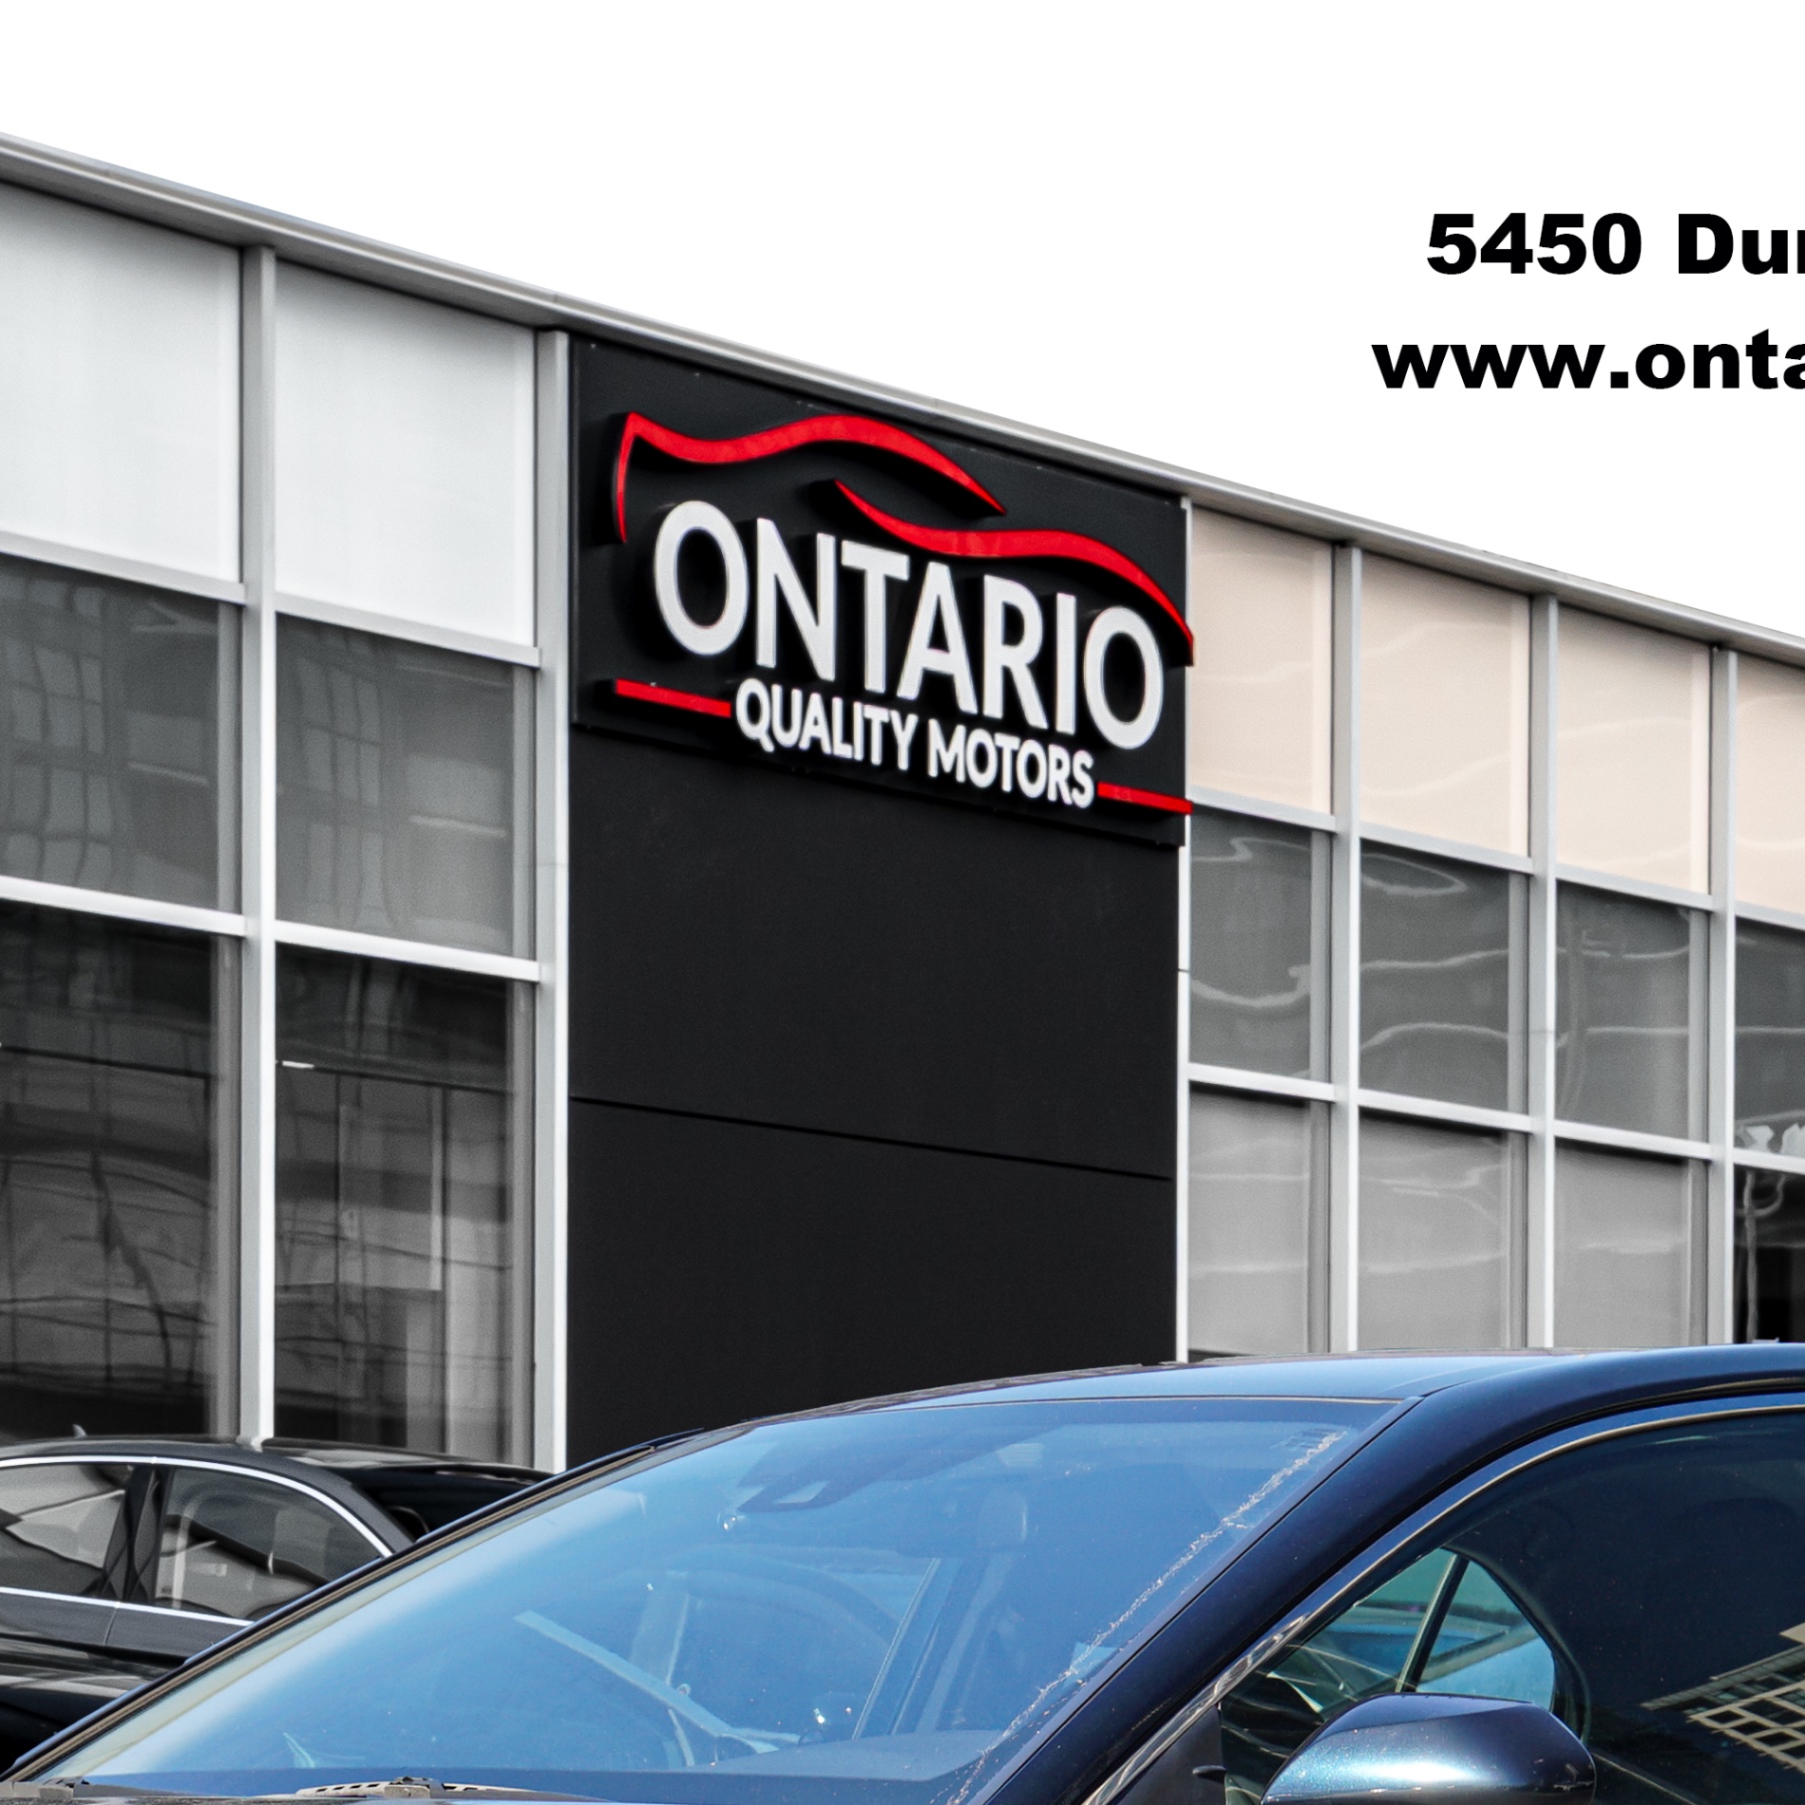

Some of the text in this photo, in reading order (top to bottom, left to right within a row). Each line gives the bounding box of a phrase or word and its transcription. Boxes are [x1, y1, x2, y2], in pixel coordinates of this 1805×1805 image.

[654, 501, 1164, 749] ONTARIO
[735, 678, 1094, 808] QUALITY MOTORS
